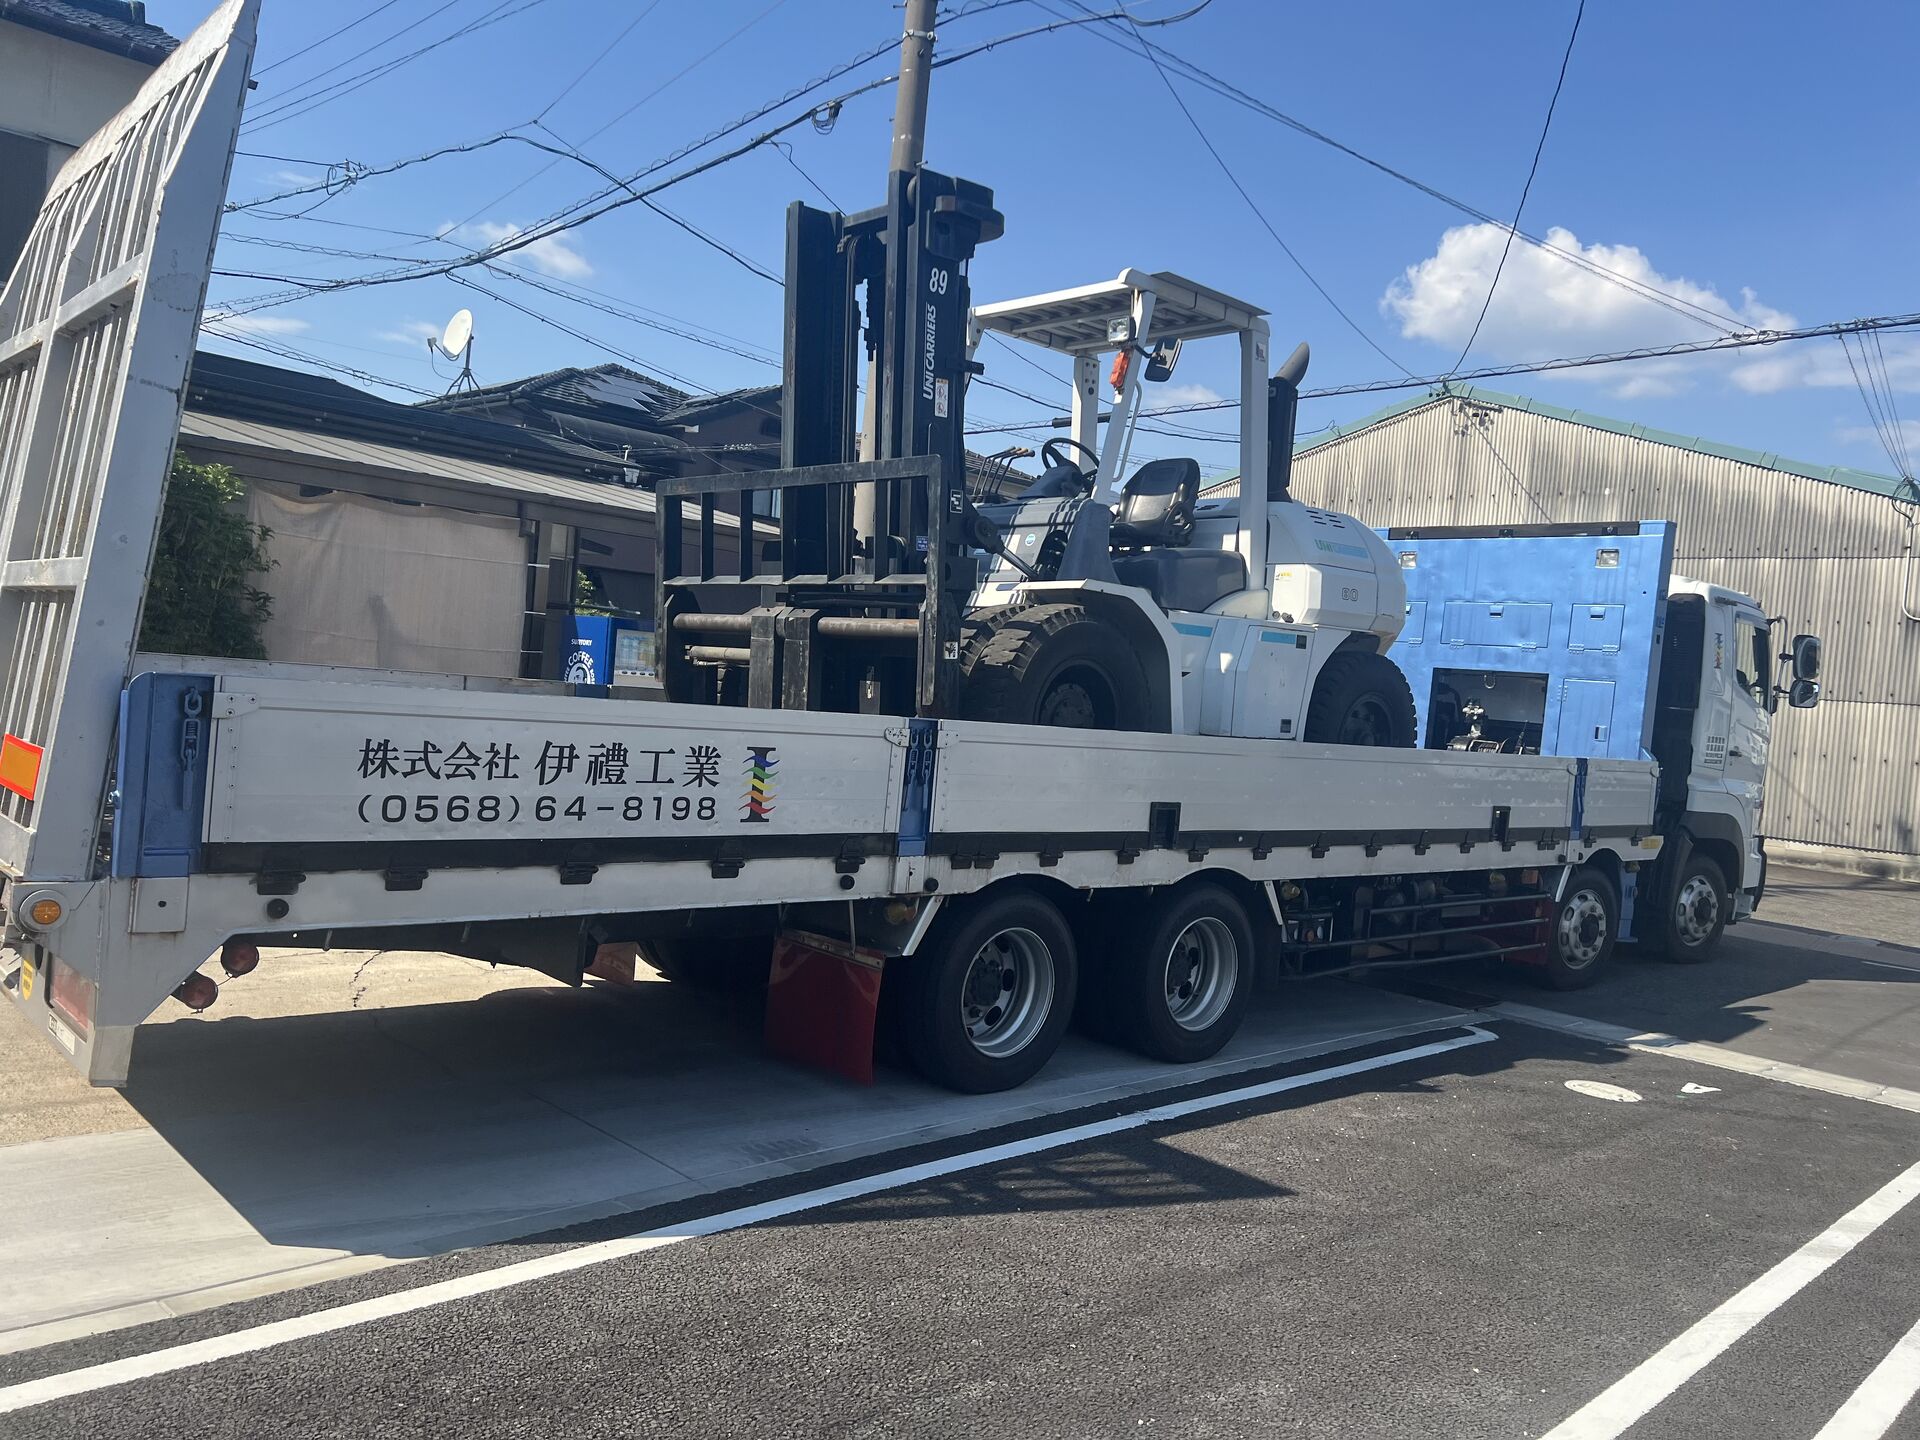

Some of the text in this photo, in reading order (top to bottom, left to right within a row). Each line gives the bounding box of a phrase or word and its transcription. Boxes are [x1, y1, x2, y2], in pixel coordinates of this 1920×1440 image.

[929, 267, 948, 296] 89
[922, 302, 937, 400] UNICARRIERS
[568, 650, 594, 669] COFFEE
[356, 737, 723, 789] 株式会社 伊禮工業
[357, 793, 718, 825] (0568)64-8198
